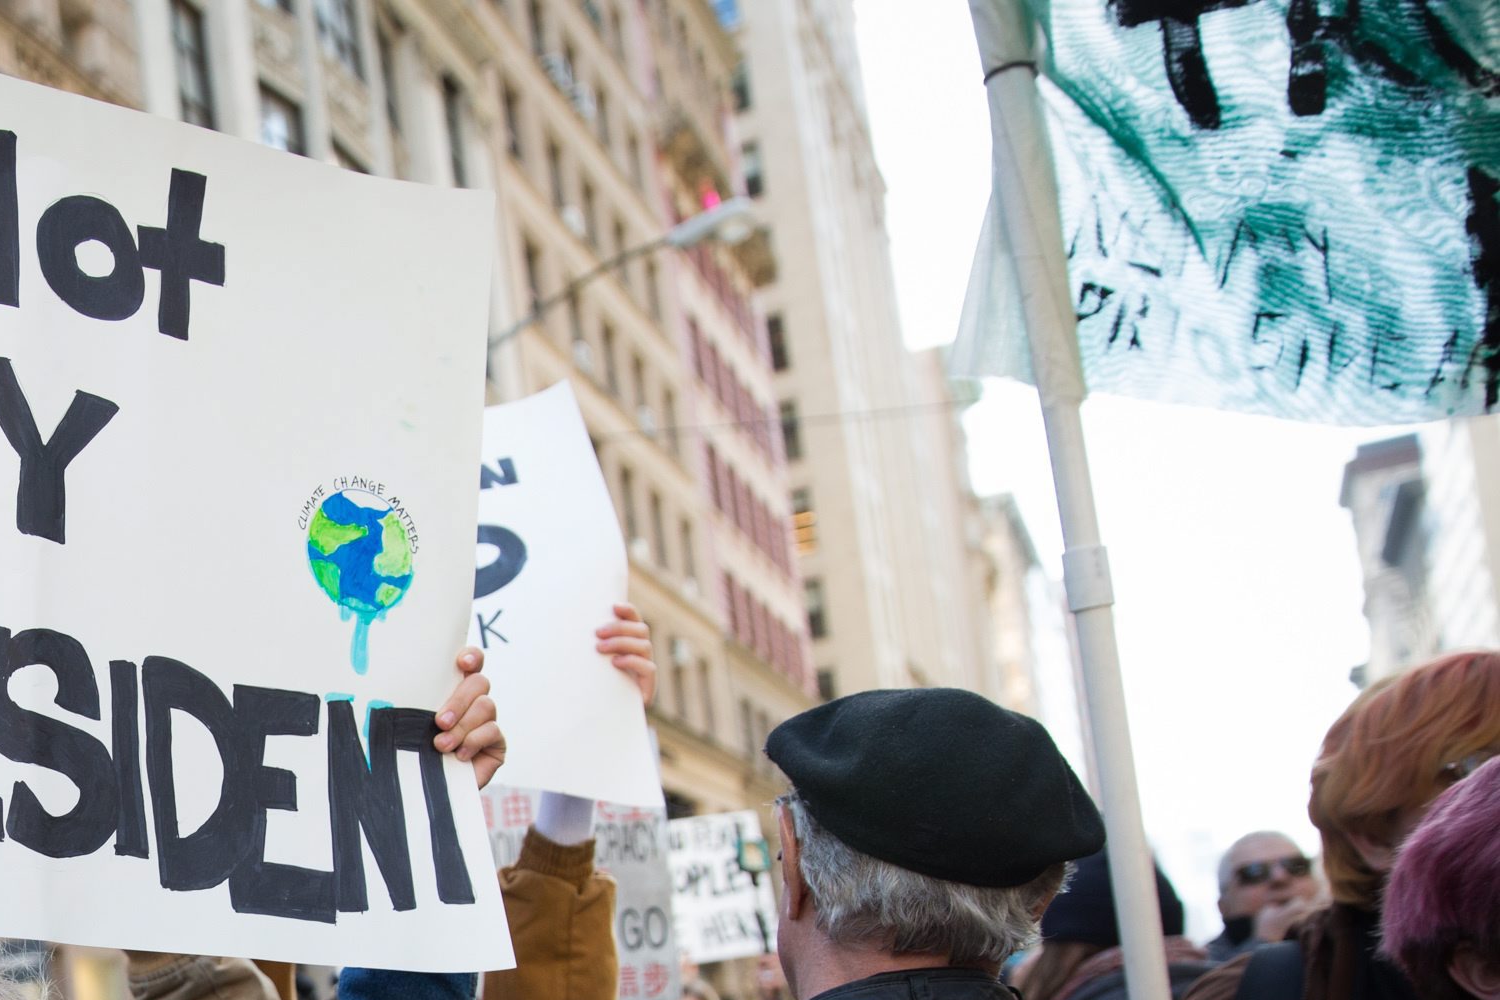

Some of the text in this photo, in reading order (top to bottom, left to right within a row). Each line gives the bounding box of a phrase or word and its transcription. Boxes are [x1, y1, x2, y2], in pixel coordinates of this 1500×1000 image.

[298, 475, 419, 554] CLIMATE CHANGE MATTERS
